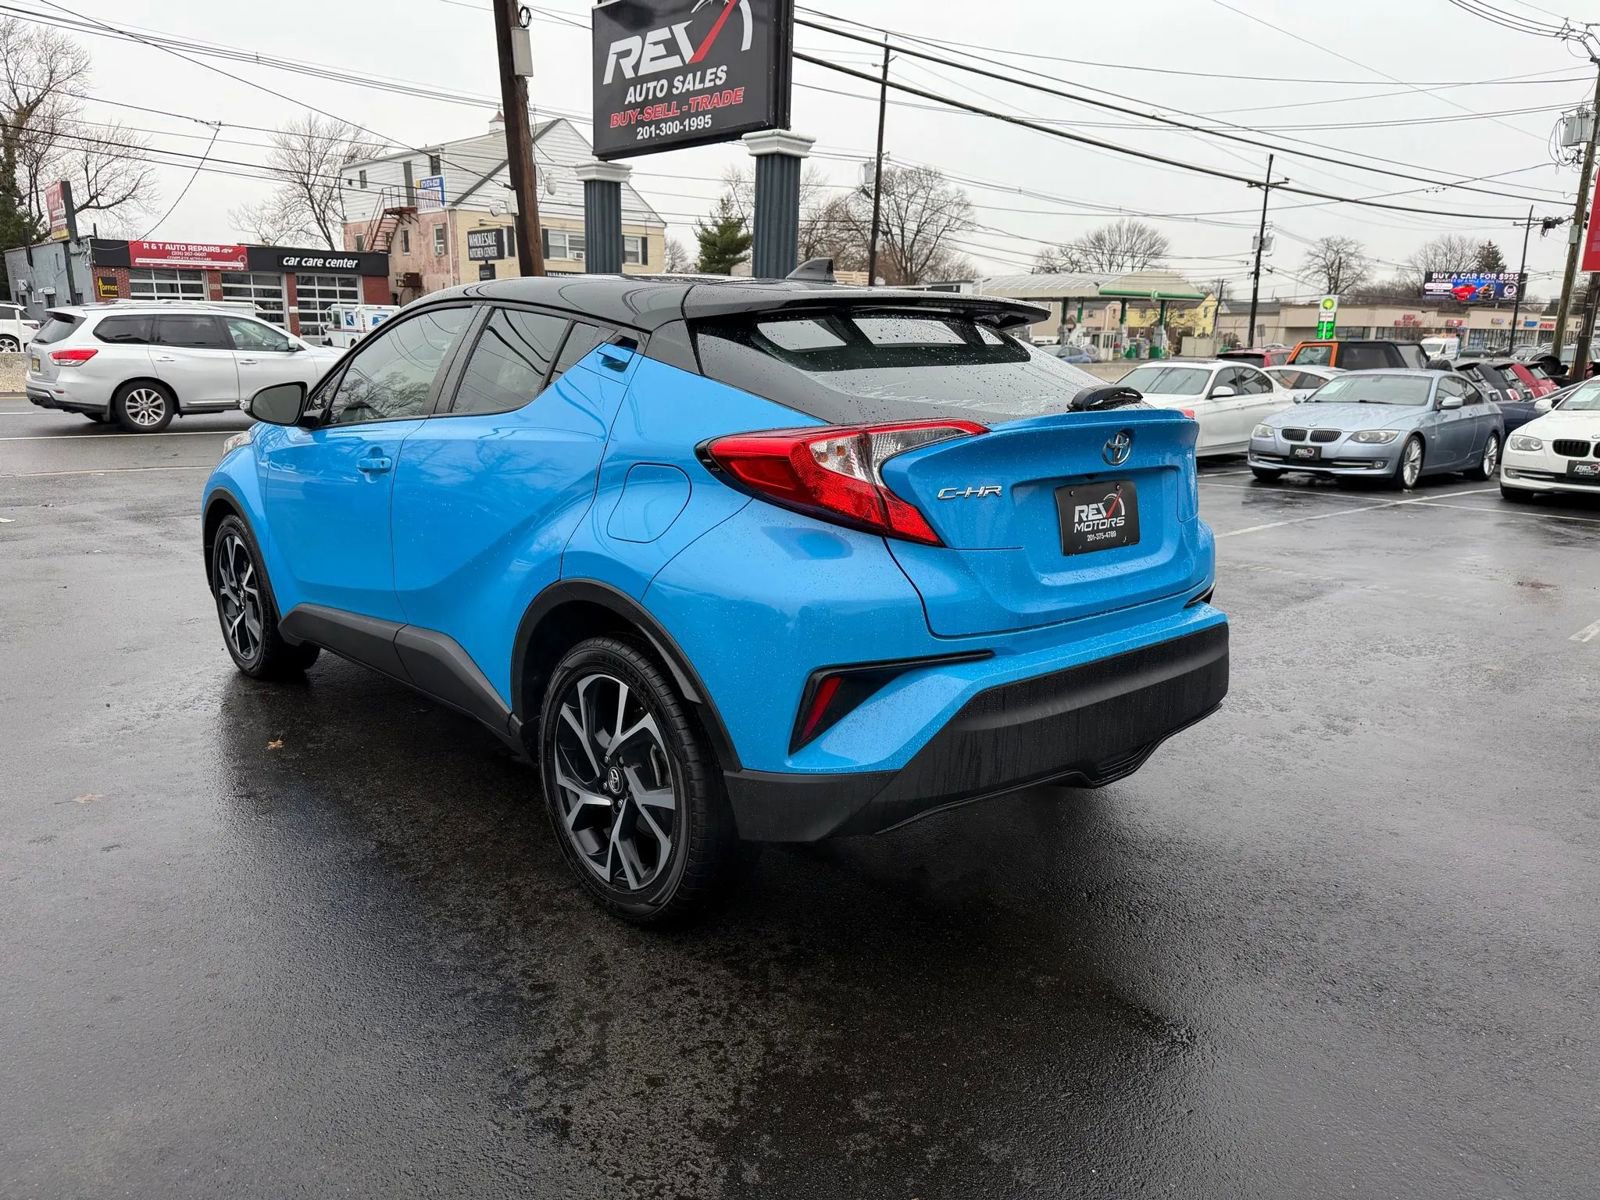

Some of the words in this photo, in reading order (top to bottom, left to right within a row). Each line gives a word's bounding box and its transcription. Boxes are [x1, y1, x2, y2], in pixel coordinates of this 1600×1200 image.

[603, 5, 730, 85] REV
[625, 78, 668, 105] AUTO
[672, 65, 728, 95] SALES
[636, 114, 712, 140] 201-300-1995
[469, 231, 496, 248] WHOLESALE
[283, 256, 300, 266] car
[302, 257, 324, 266] care
[326, 258, 358, 268] center
[938, 486, 1002, 499] C-HR
[1074, 516, 1125, 533] MOTORS
